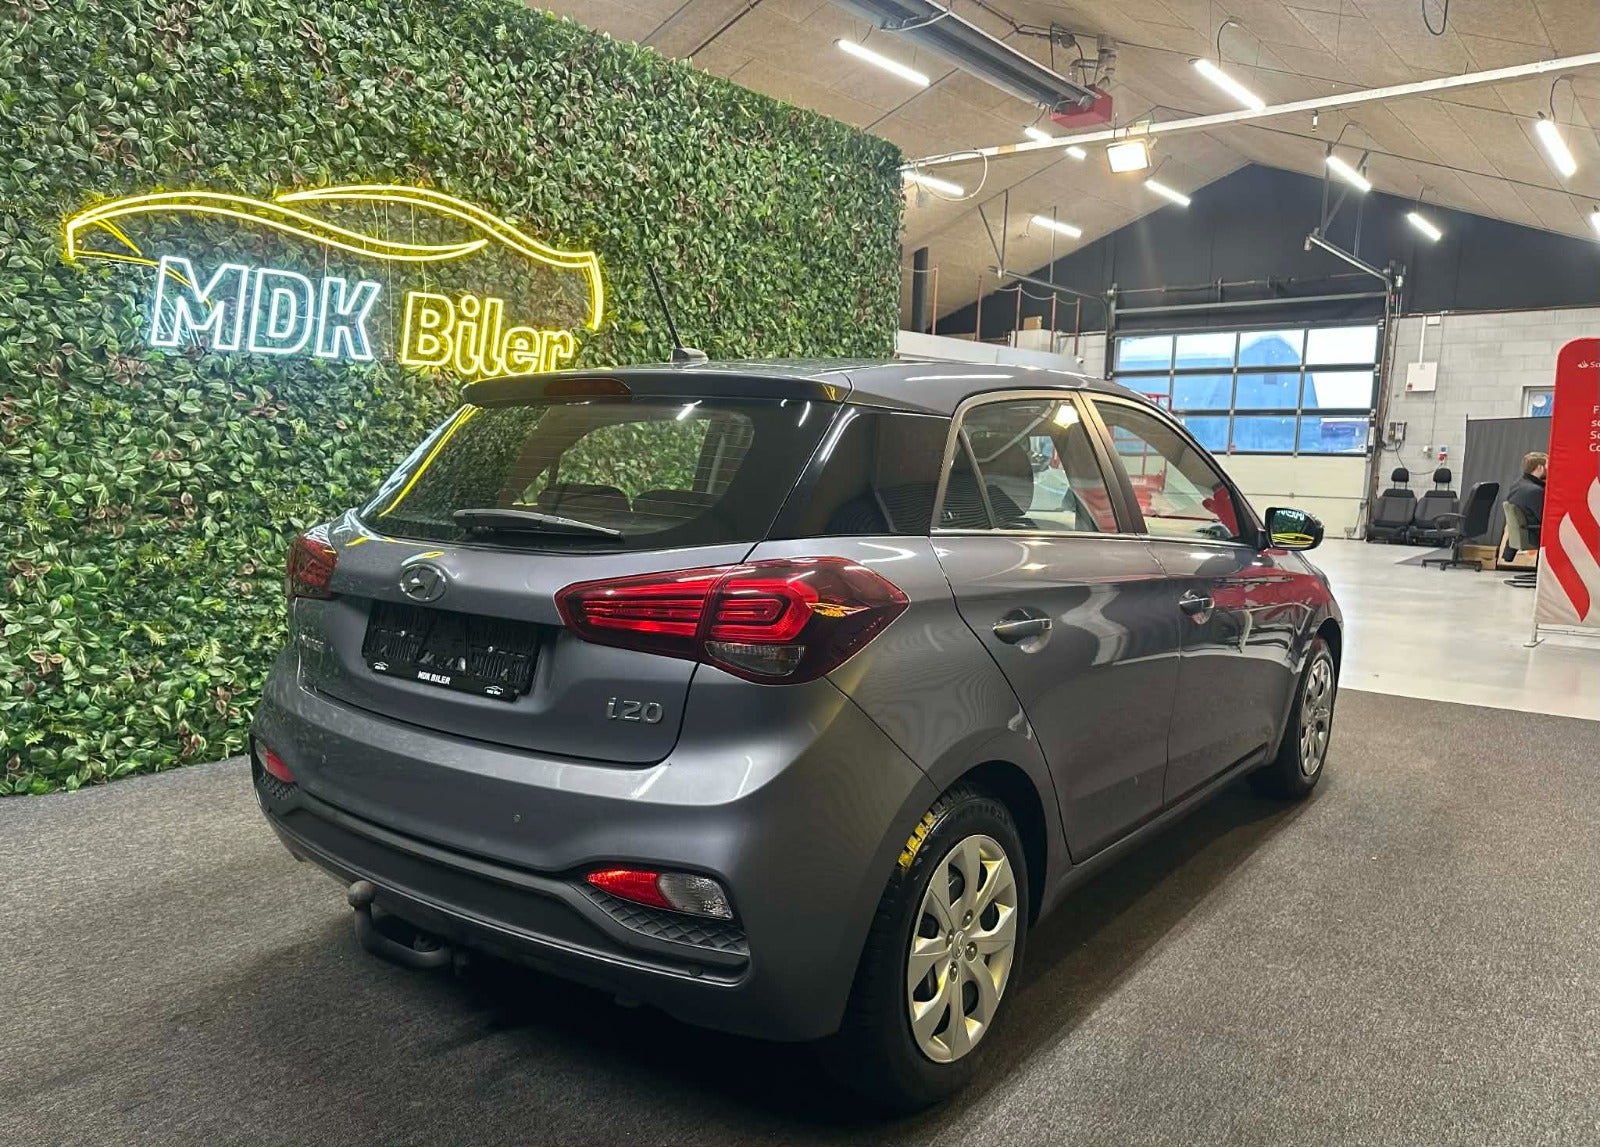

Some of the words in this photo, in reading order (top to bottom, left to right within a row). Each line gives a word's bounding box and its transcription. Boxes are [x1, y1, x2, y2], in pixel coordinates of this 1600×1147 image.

[150, 254, 381, 361] MDK
[401, 290, 574, 376] Biler
[430, 673, 451, 685] BILER
[606, 697, 663, 723] i20
